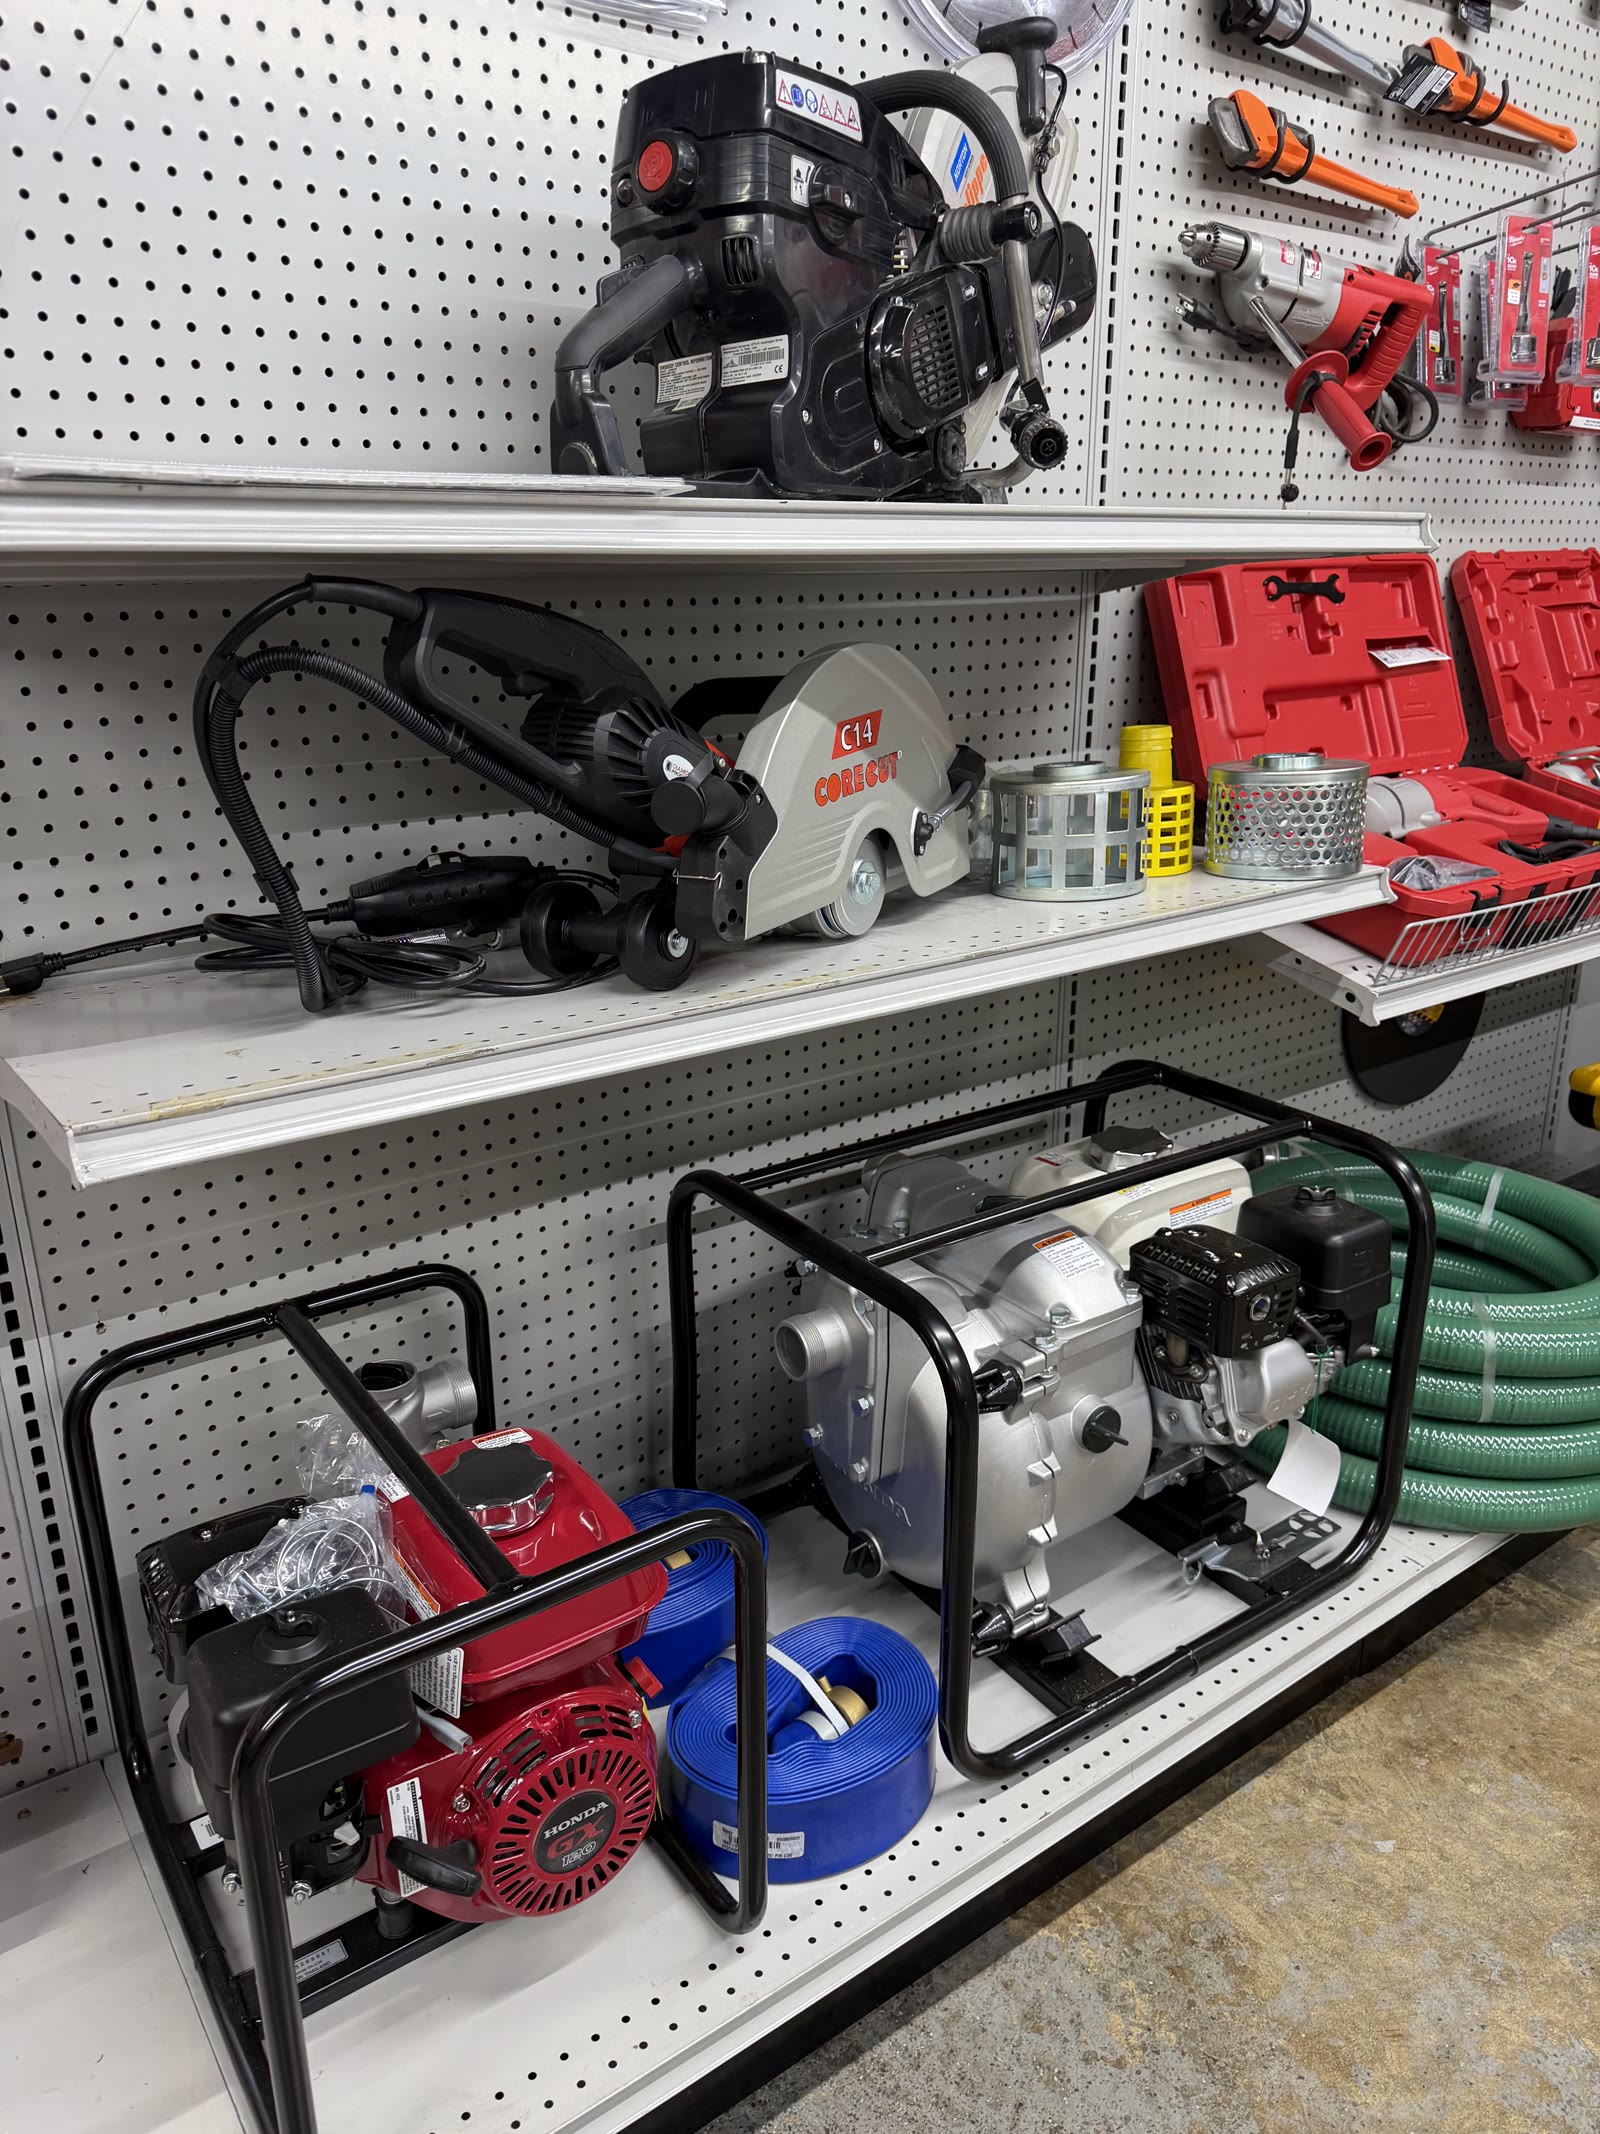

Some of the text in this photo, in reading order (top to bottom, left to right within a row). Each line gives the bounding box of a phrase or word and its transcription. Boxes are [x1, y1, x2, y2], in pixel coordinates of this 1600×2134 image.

[952, 143, 968, 182] NORTON
[963, 153, 988, 208] lippe
[841, 718, 872, 751] C14
[543, 1801, 609, 1839] HONDA
[547, 1814, 606, 1859] GX
[562, 1840, 597, 1867] 120
